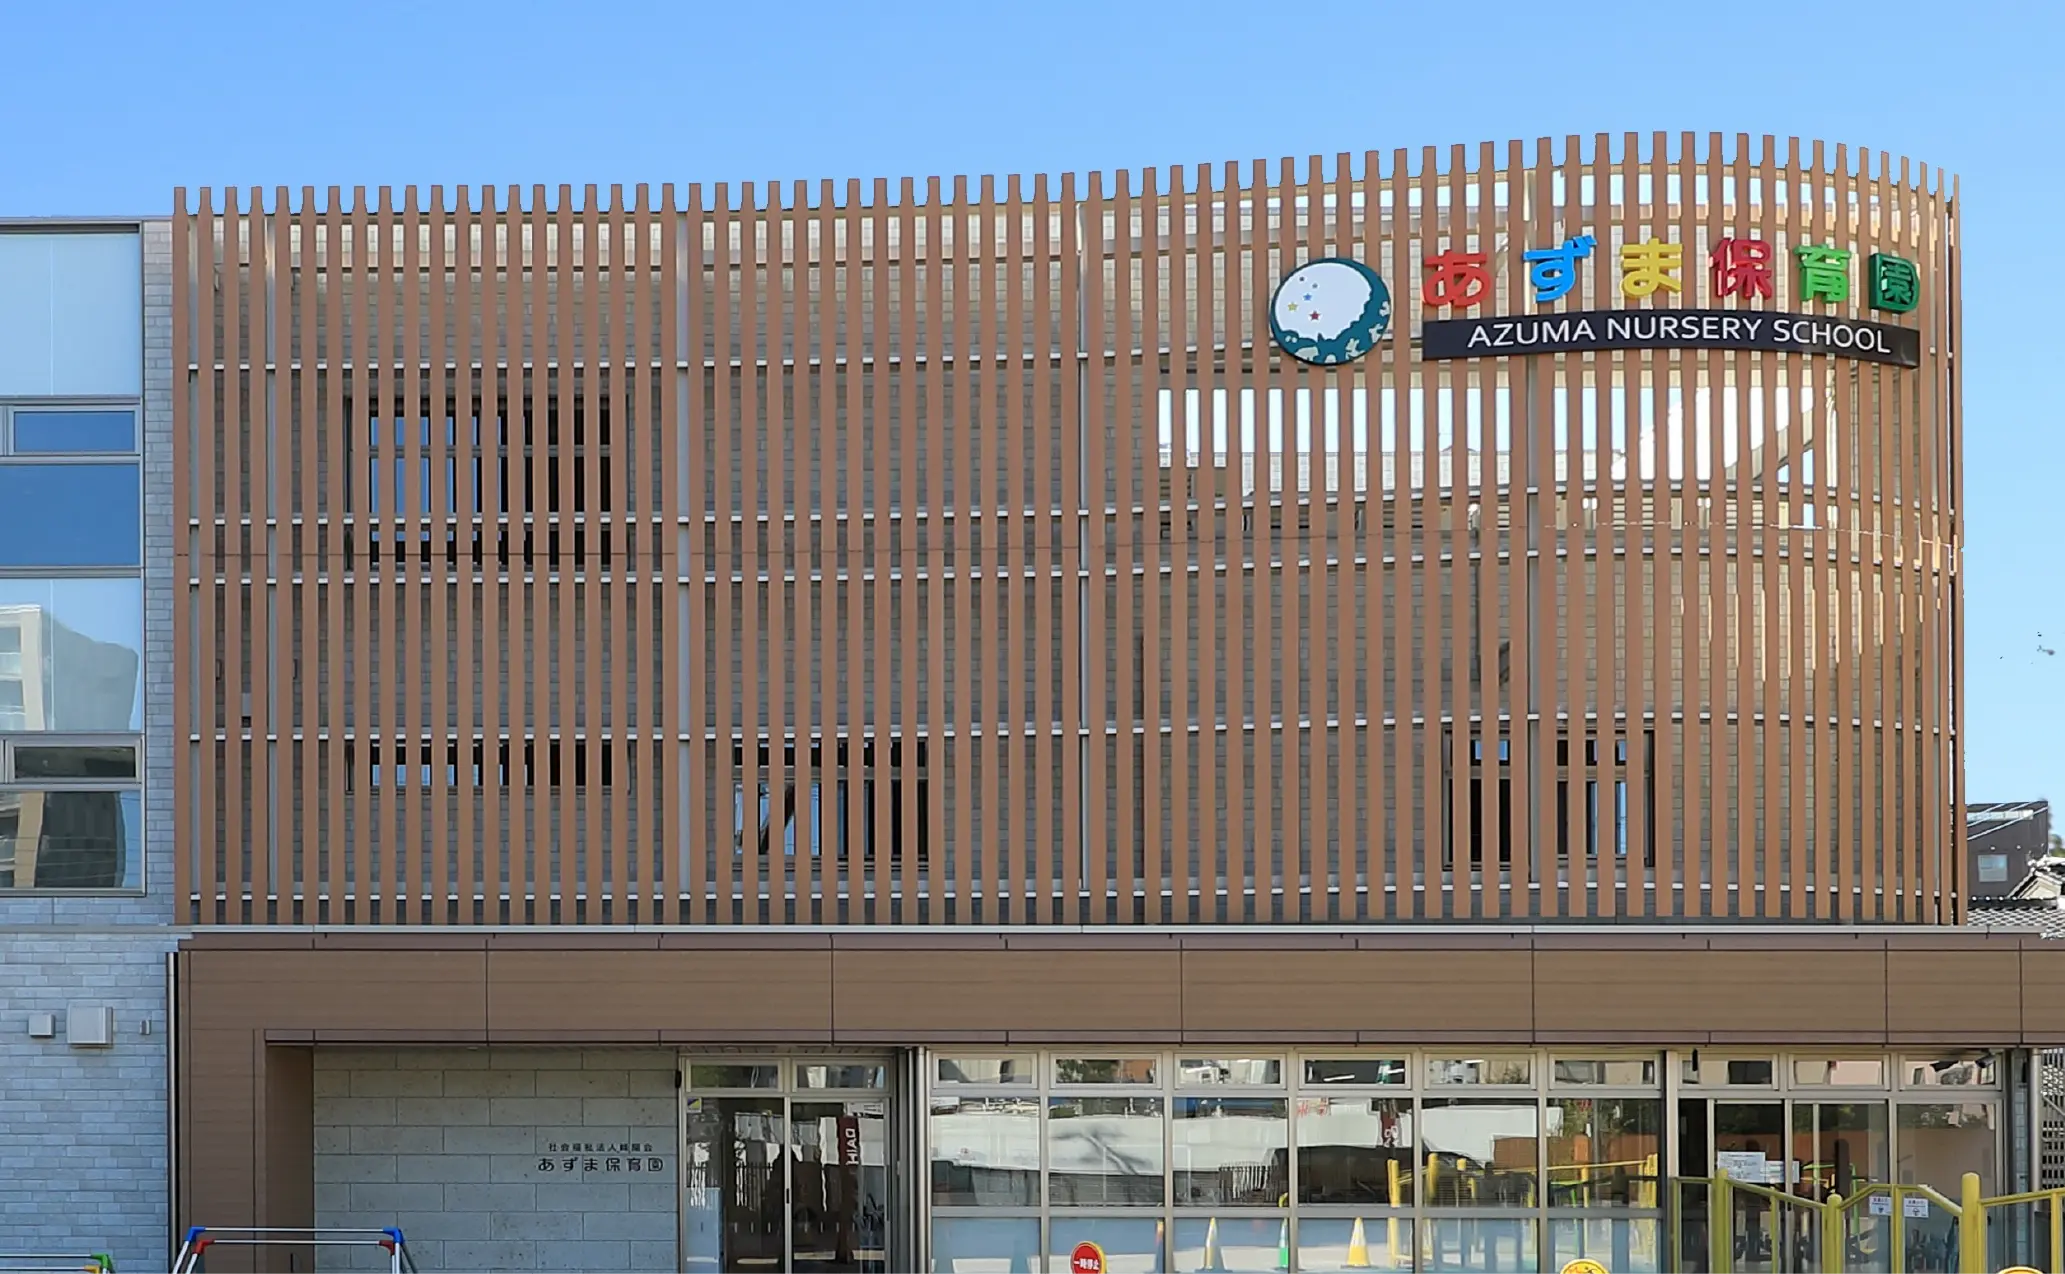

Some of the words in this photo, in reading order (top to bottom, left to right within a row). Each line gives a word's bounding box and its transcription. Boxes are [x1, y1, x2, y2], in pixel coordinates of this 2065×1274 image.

[1421, 234, 1921, 314] あずま保育園
[1466, 316, 1596, 349] AZUMA
[1606, 315, 1763, 343] NURSERY
[1772, 319, 1892, 354] SCHOOL
[538, 1156, 664, 1172] あずま保育園
[1073, 1258, 1100, 1271] 一時停止
